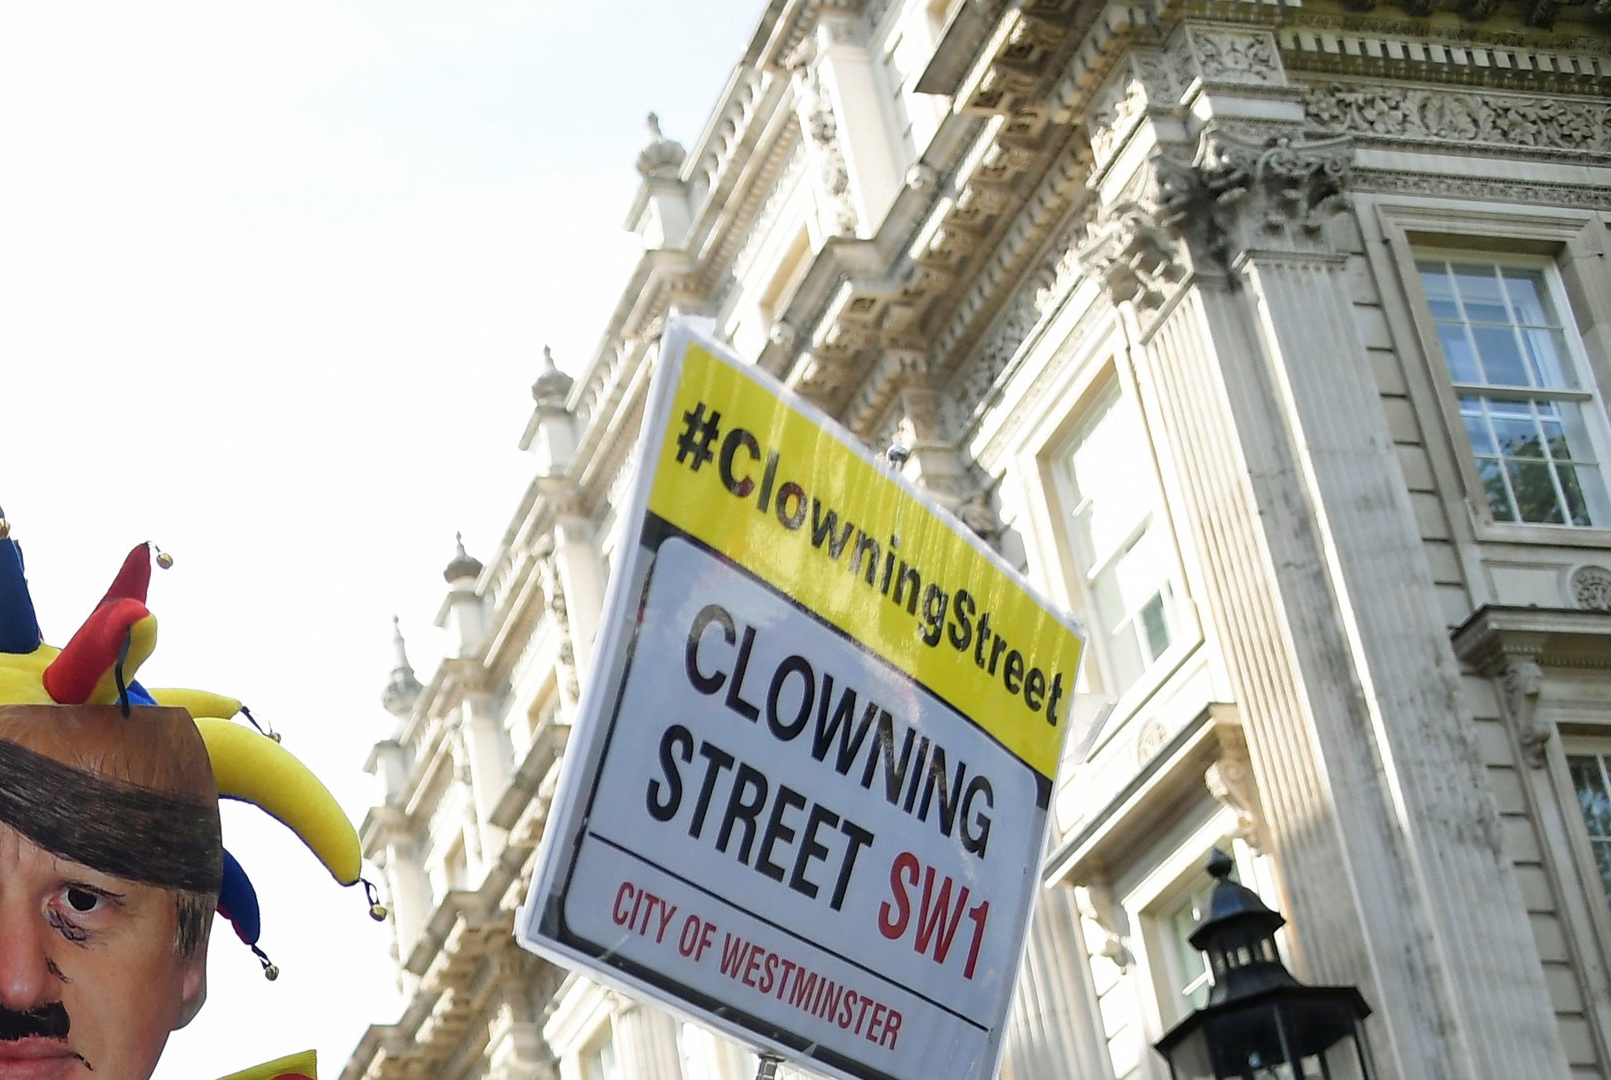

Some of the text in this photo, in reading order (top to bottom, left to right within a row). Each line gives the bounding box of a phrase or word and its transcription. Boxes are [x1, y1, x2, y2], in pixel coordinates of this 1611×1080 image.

[675, 402, 1062, 727] #ClowningStreet
[646, 725, 989, 980] STREET SW1
[685, 605, 994, 859] CLOWNING
[612, 882, 902, 1051] CITY OF WESTMINSTER
